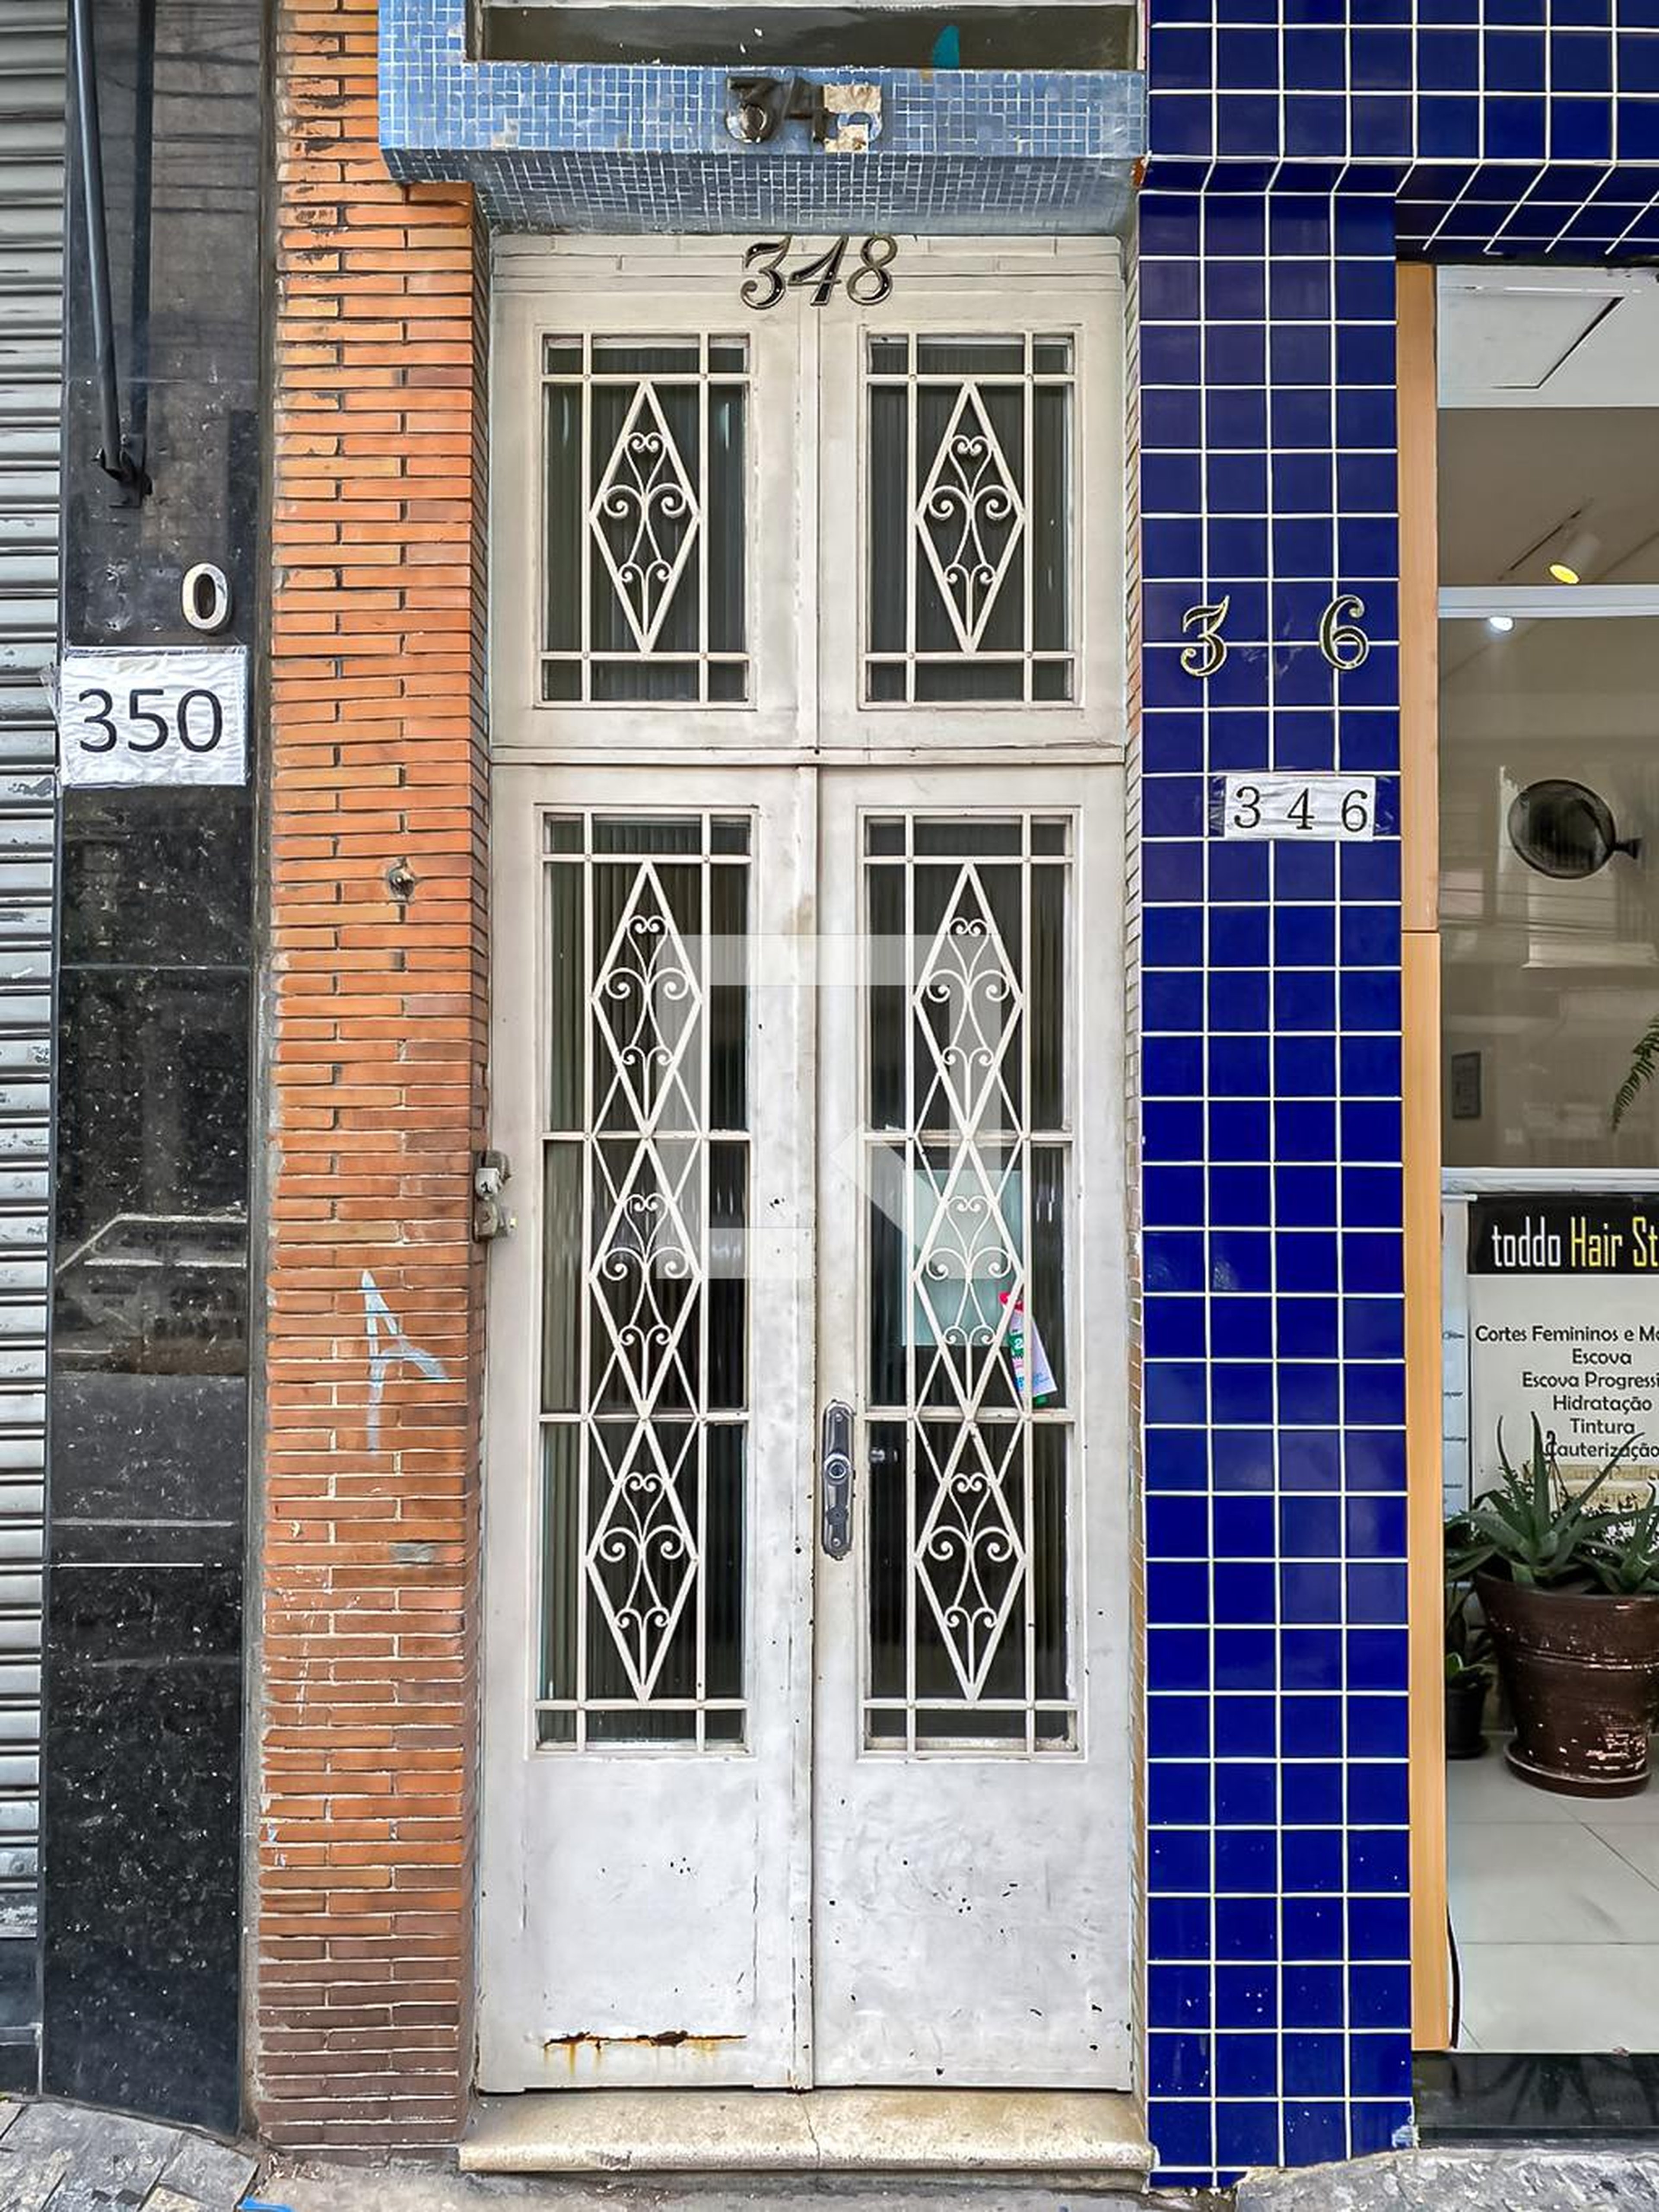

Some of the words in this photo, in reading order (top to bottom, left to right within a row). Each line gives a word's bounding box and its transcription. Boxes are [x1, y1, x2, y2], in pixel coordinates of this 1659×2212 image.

[741, 235, 898, 309] 348
[182, 562, 229, 631] 0
[78, 688, 223, 753] 350
[1492, 1216, 1561, 1267] toddo
[1570, 1216, 1622, 1267] Hair
[1475, 1326, 1527, 1342] Cortes
[1532, 1326, 1619, 1342] Femininos
[1624, 1330, 1635, 1342] e
[1640, 1325, 1659, 1341] M
[1572, 1349, 1632, 1365] Escova
[1522, 1372, 1580, 1388] Escova
[1553, 1395, 1652, 1414] Hidratação
[1570, 1418, 1635, 1434] Tintura
